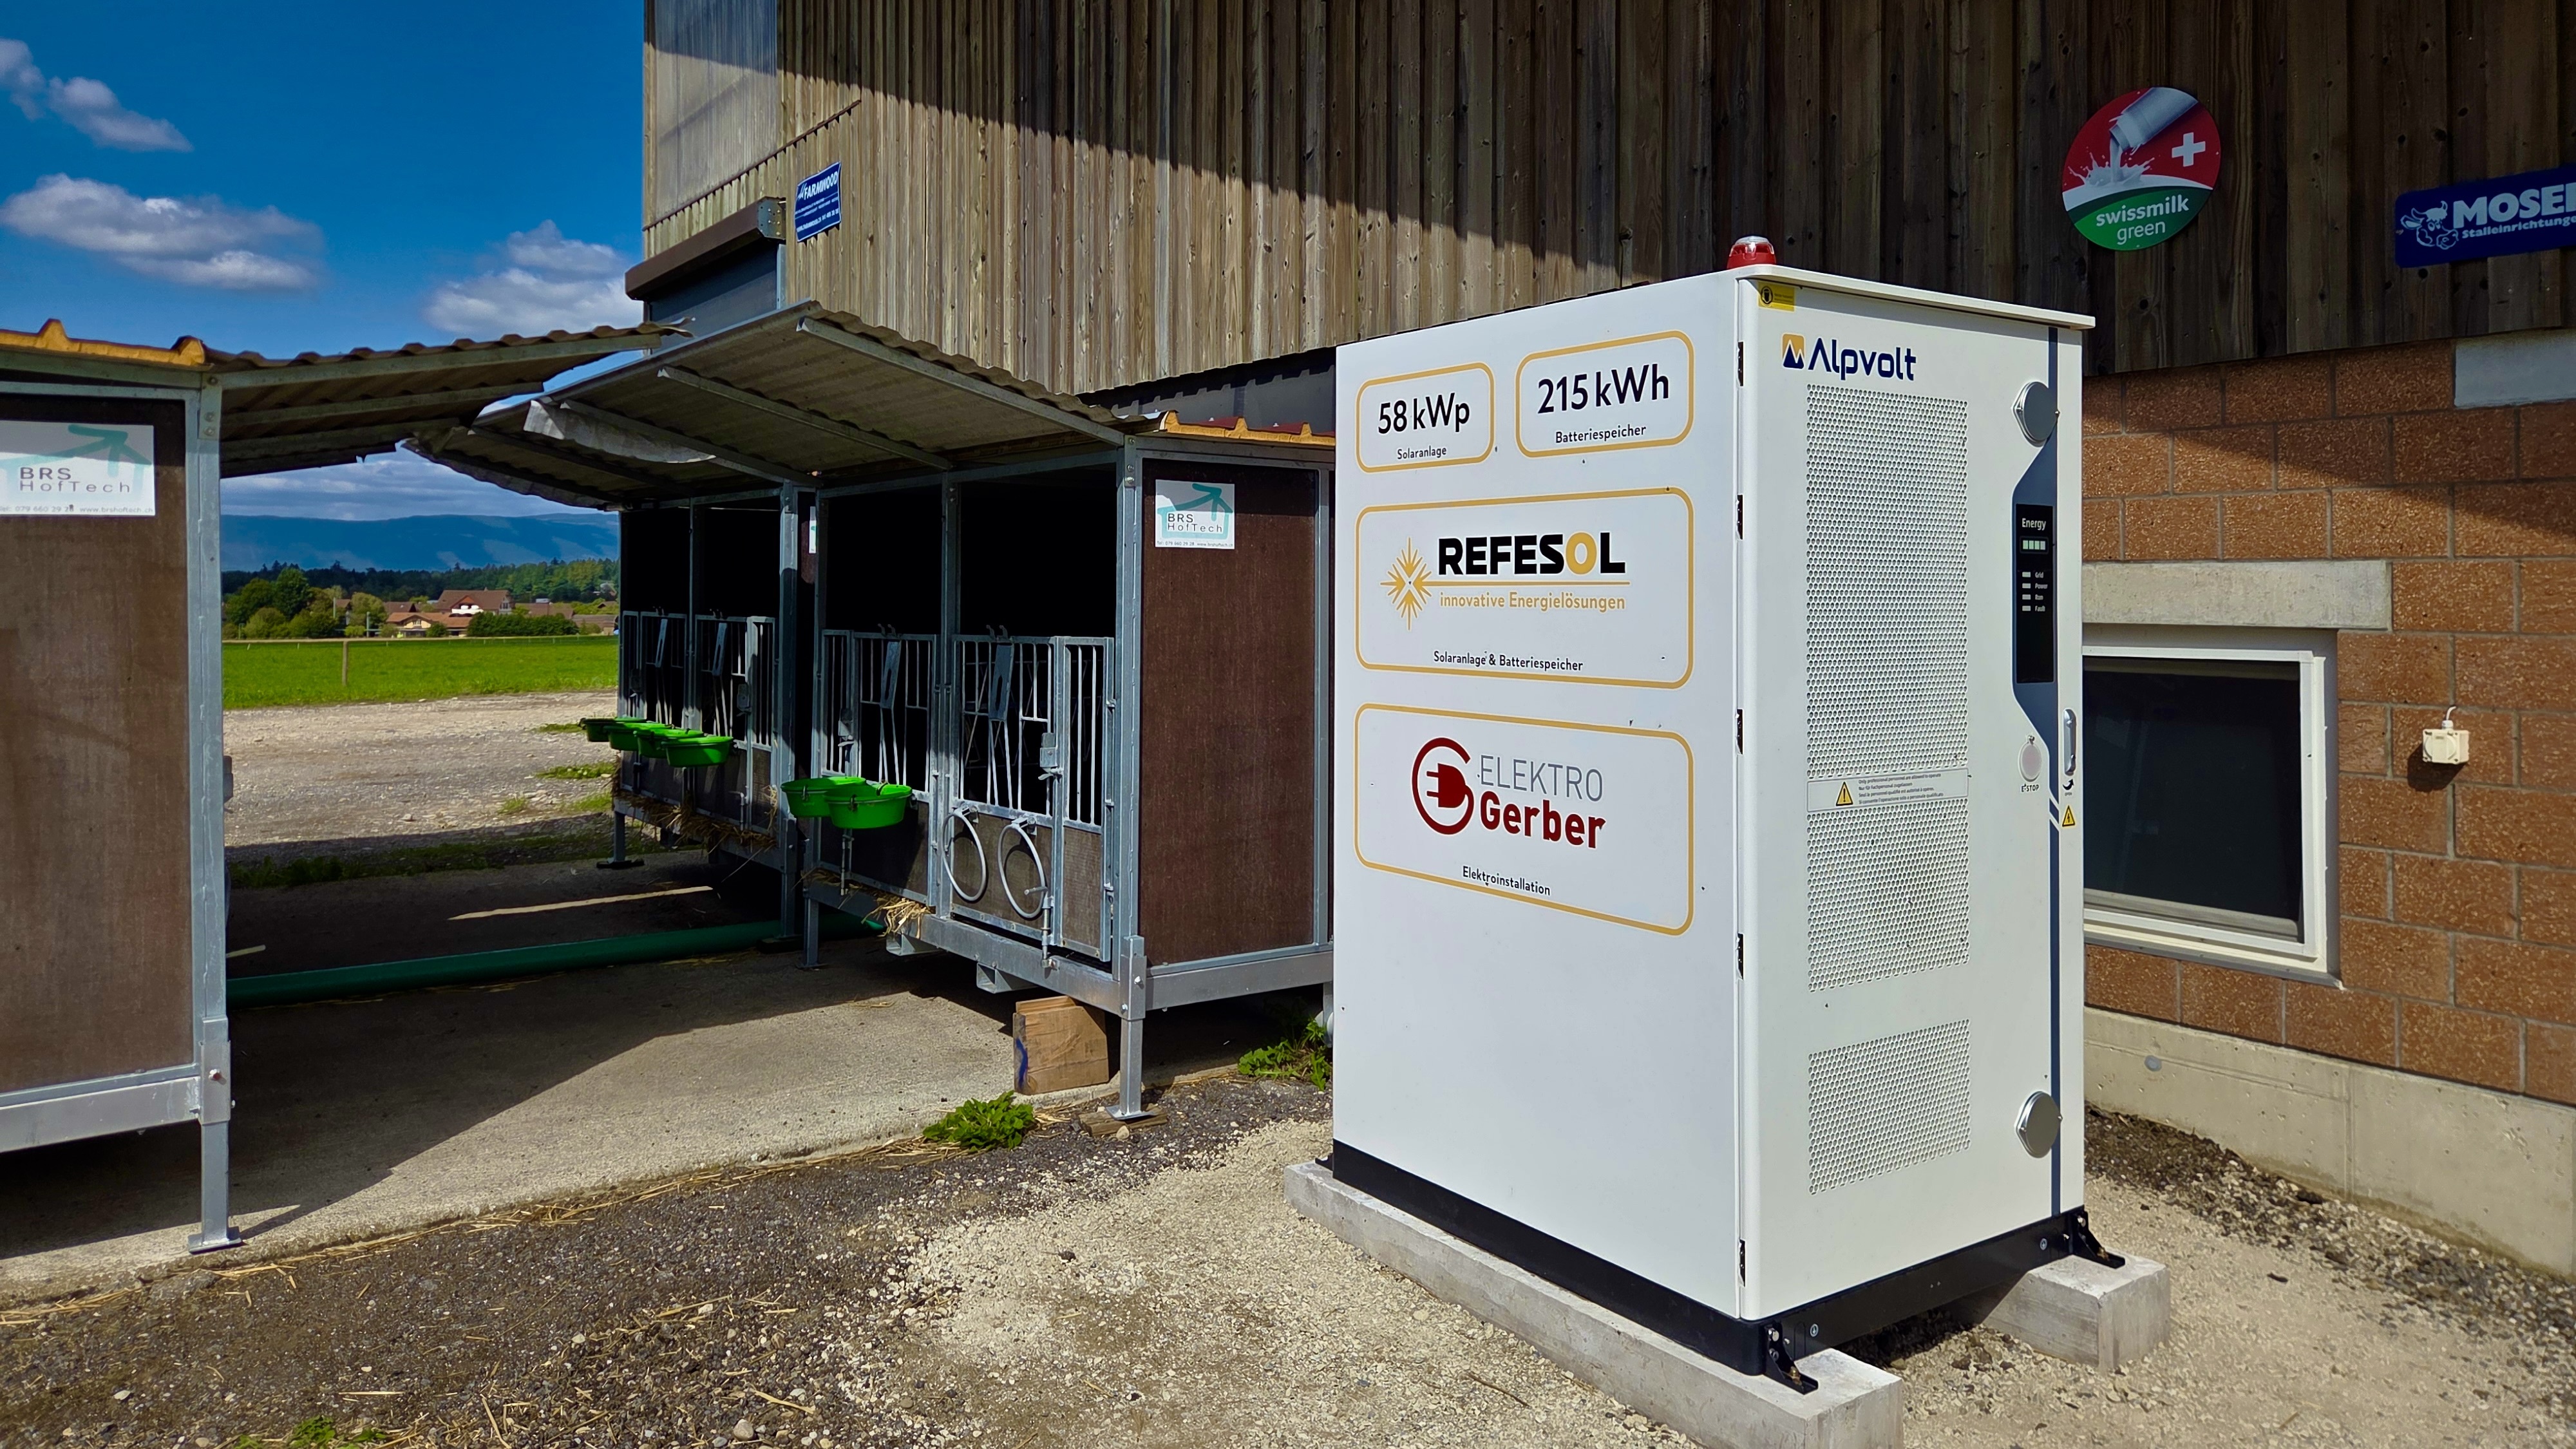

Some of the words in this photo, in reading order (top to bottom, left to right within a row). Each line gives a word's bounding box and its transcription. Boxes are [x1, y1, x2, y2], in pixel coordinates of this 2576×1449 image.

[804, 171, 838, 200] FARMWOOD
[2096, 194, 2190, 227] swissmilk
[2117, 220, 2166, 245] green
[1808, 337, 1917, 381] Alpvolt
[1537, 374, 1588, 414] 215
[1596, 363, 1669, 407] kWh
[1378, 400, 1407, 434] 58
[1413, 392, 1470, 432] kWp
[1555, 424, 1647, 443] Batteriespeicher
[1397, 445, 1447, 459] Solaranlage
[20, 467, 71, 480] BRS
[20, 480, 129, 493] HofTech
[1168, 513, 1193, 523] BRS
[1168, 523, 1222, 533] HofTech
[2022, 518, 2047, 531] Energy
[1438, 532, 1625, 576] REFESOL
[1440, 592, 1505, 608] innovative
[1510, 592, 1625, 612] Energielösungen
[1434, 650, 1486, 667] Solaranlage
[1488, 654, 1497, 666] &
[1499, 654, 1584, 672] Batteriespeicher
[1481, 755, 1603, 802] ELEKTRO
[1481, 791, 1606, 849] Gerber
[1463, 866, 1551, 896] Elektroinstallation
